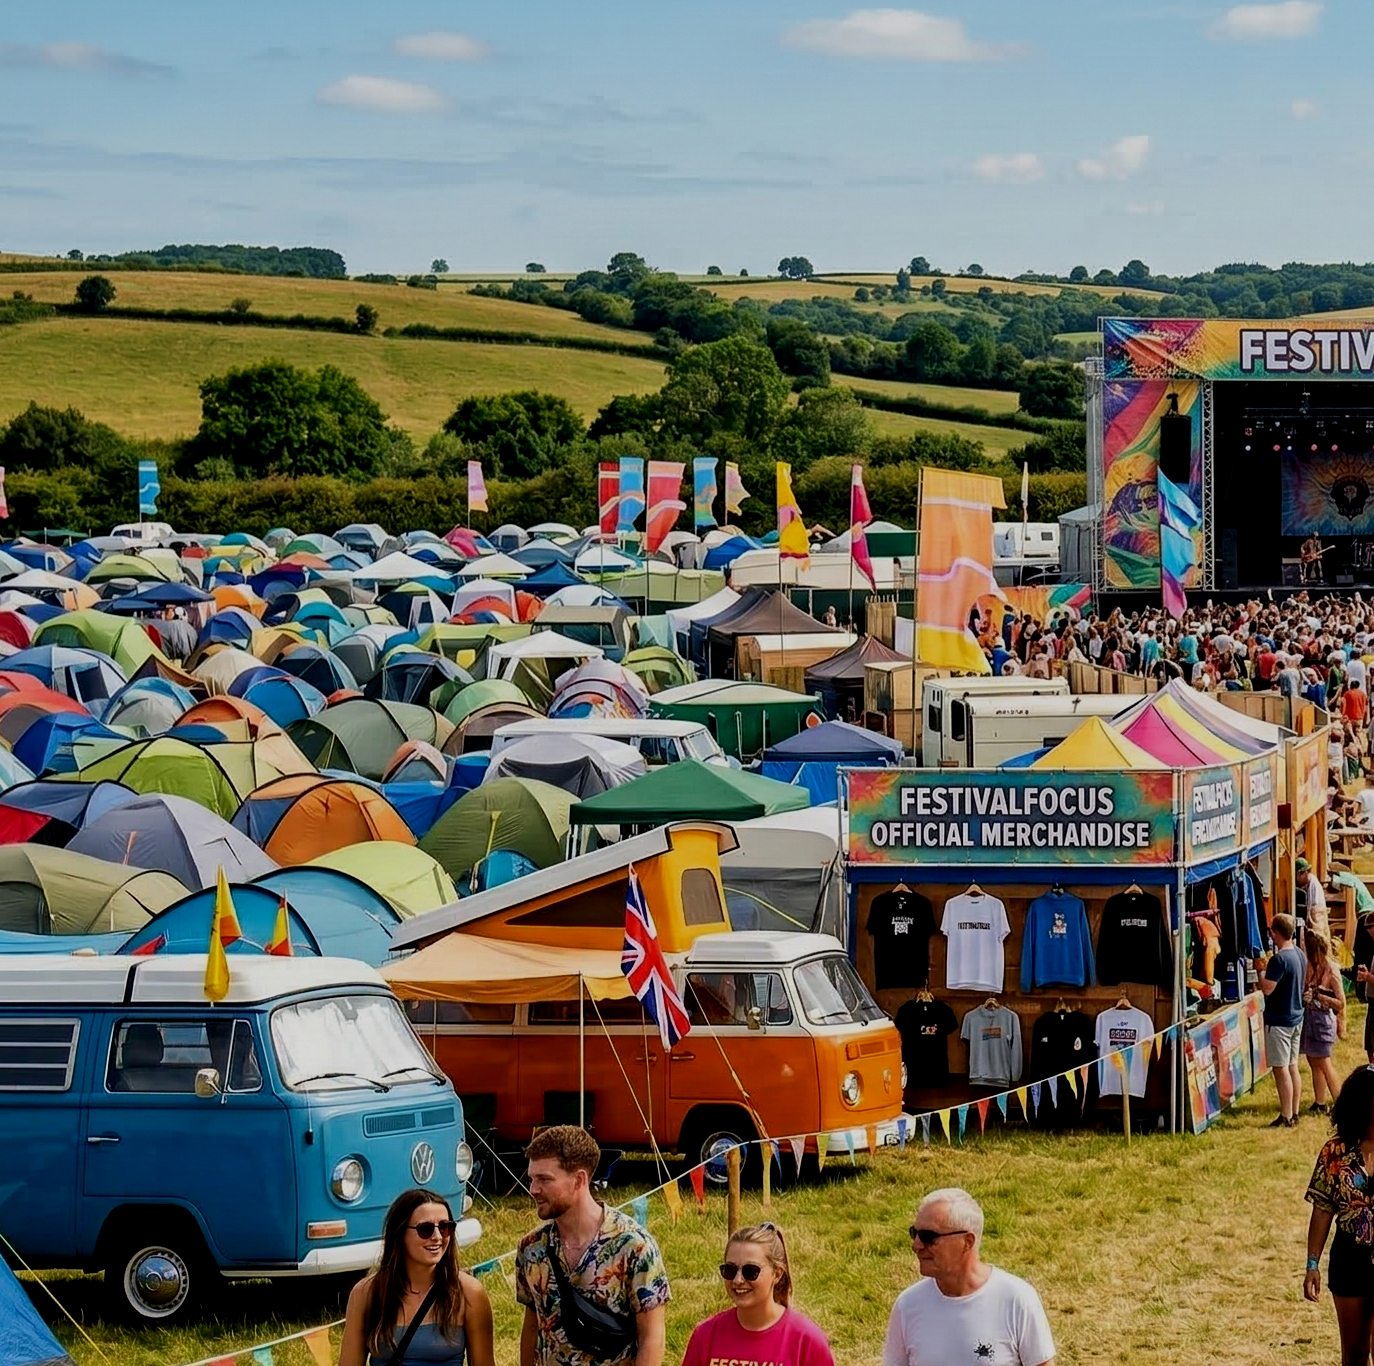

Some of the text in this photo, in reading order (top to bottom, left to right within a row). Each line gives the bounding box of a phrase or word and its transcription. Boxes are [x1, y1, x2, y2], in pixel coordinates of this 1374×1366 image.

[901, 787, 1114, 816] FESTIVALFOCUS
[871, 822, 1150, 848] OFFICIAL MERCHANDISE
